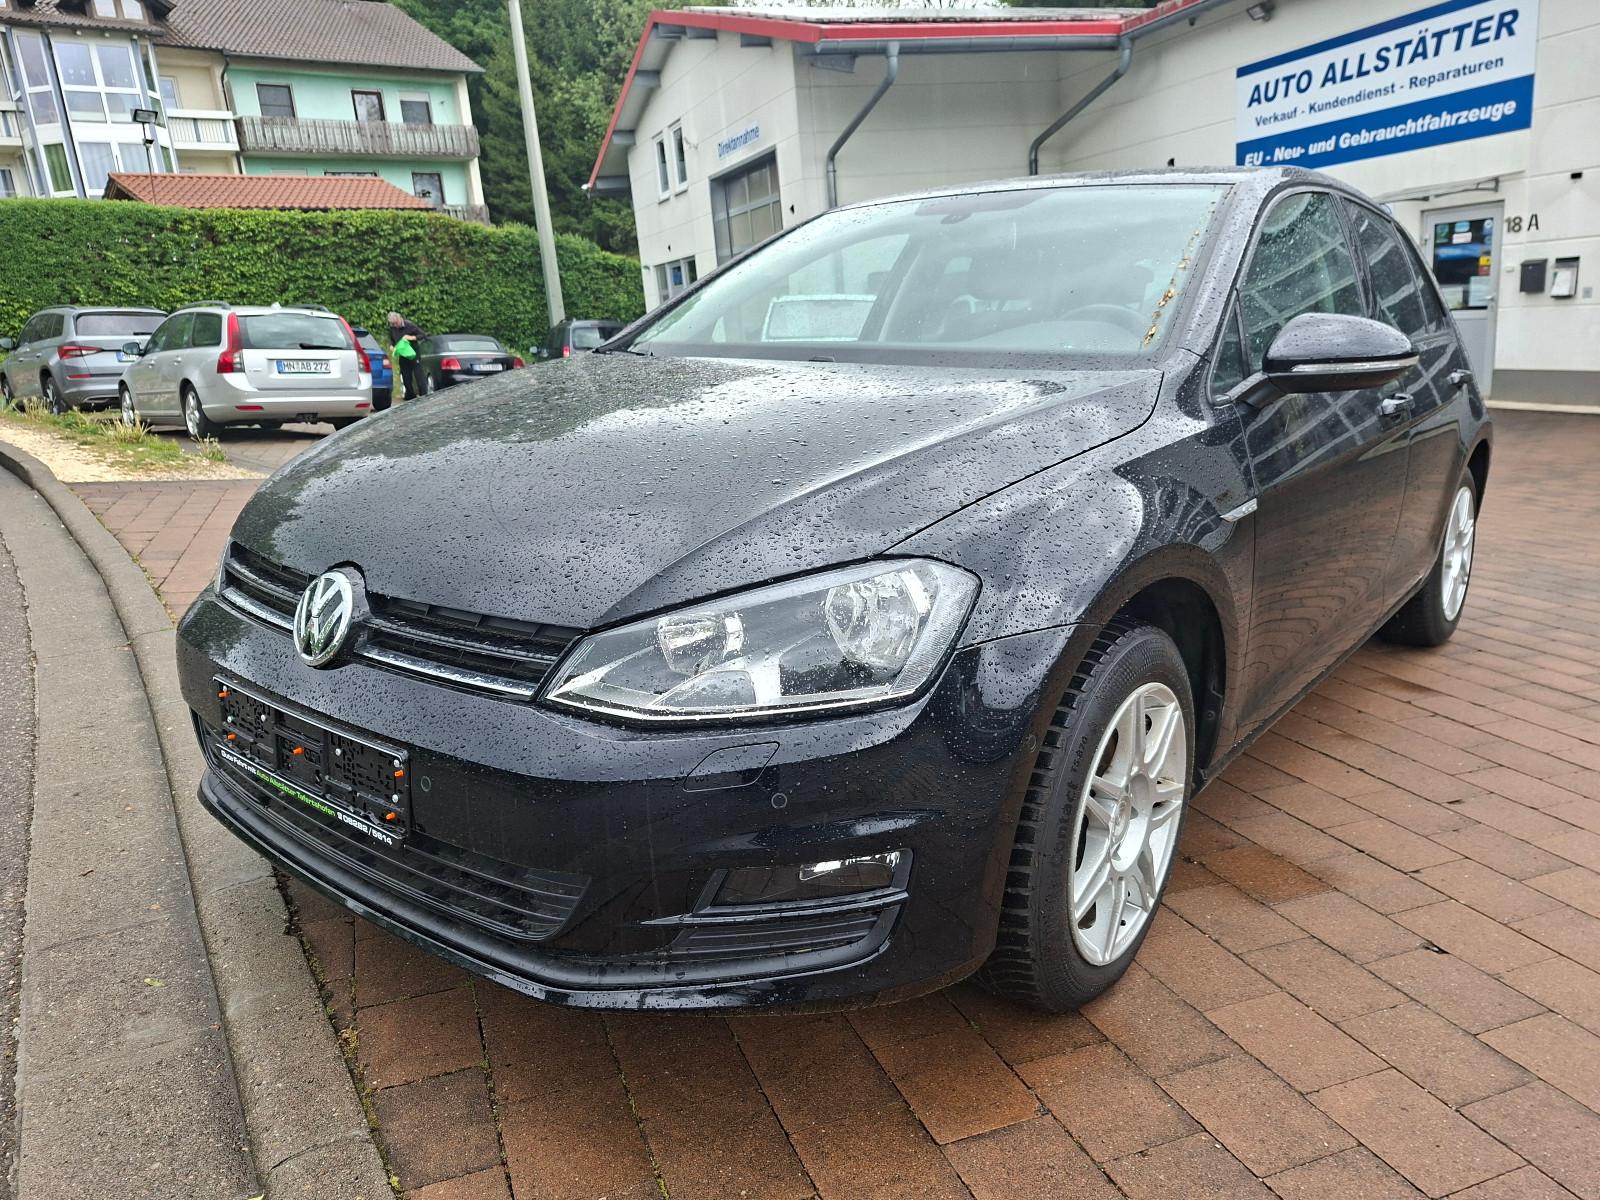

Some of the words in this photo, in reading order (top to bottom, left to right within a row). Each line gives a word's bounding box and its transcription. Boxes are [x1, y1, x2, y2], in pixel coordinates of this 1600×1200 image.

[1247, 69, 1313, 108] AUTO
[1320, 8, 1520, 88] ALLSTÄTTER
[1255, 107, 1298, 127] Verkauf
[1309, 83, 1396, 114] Kundendienst
[1409, 57, 1504, 89] Reparaturen
[1244, 151, 1264, 166] EU
[1273, 145, 1306, 162] Neu-
[1308, 135, 1337, 155] und
[1339, 99, 1517, 149] Gebrauchtfahrzeuge
[1505, 216, 1522, 233] 18
[1527, 214, 1540, 231] A
[300, 362, 312, 371] AB
[313, 362, 330, 371] 272
